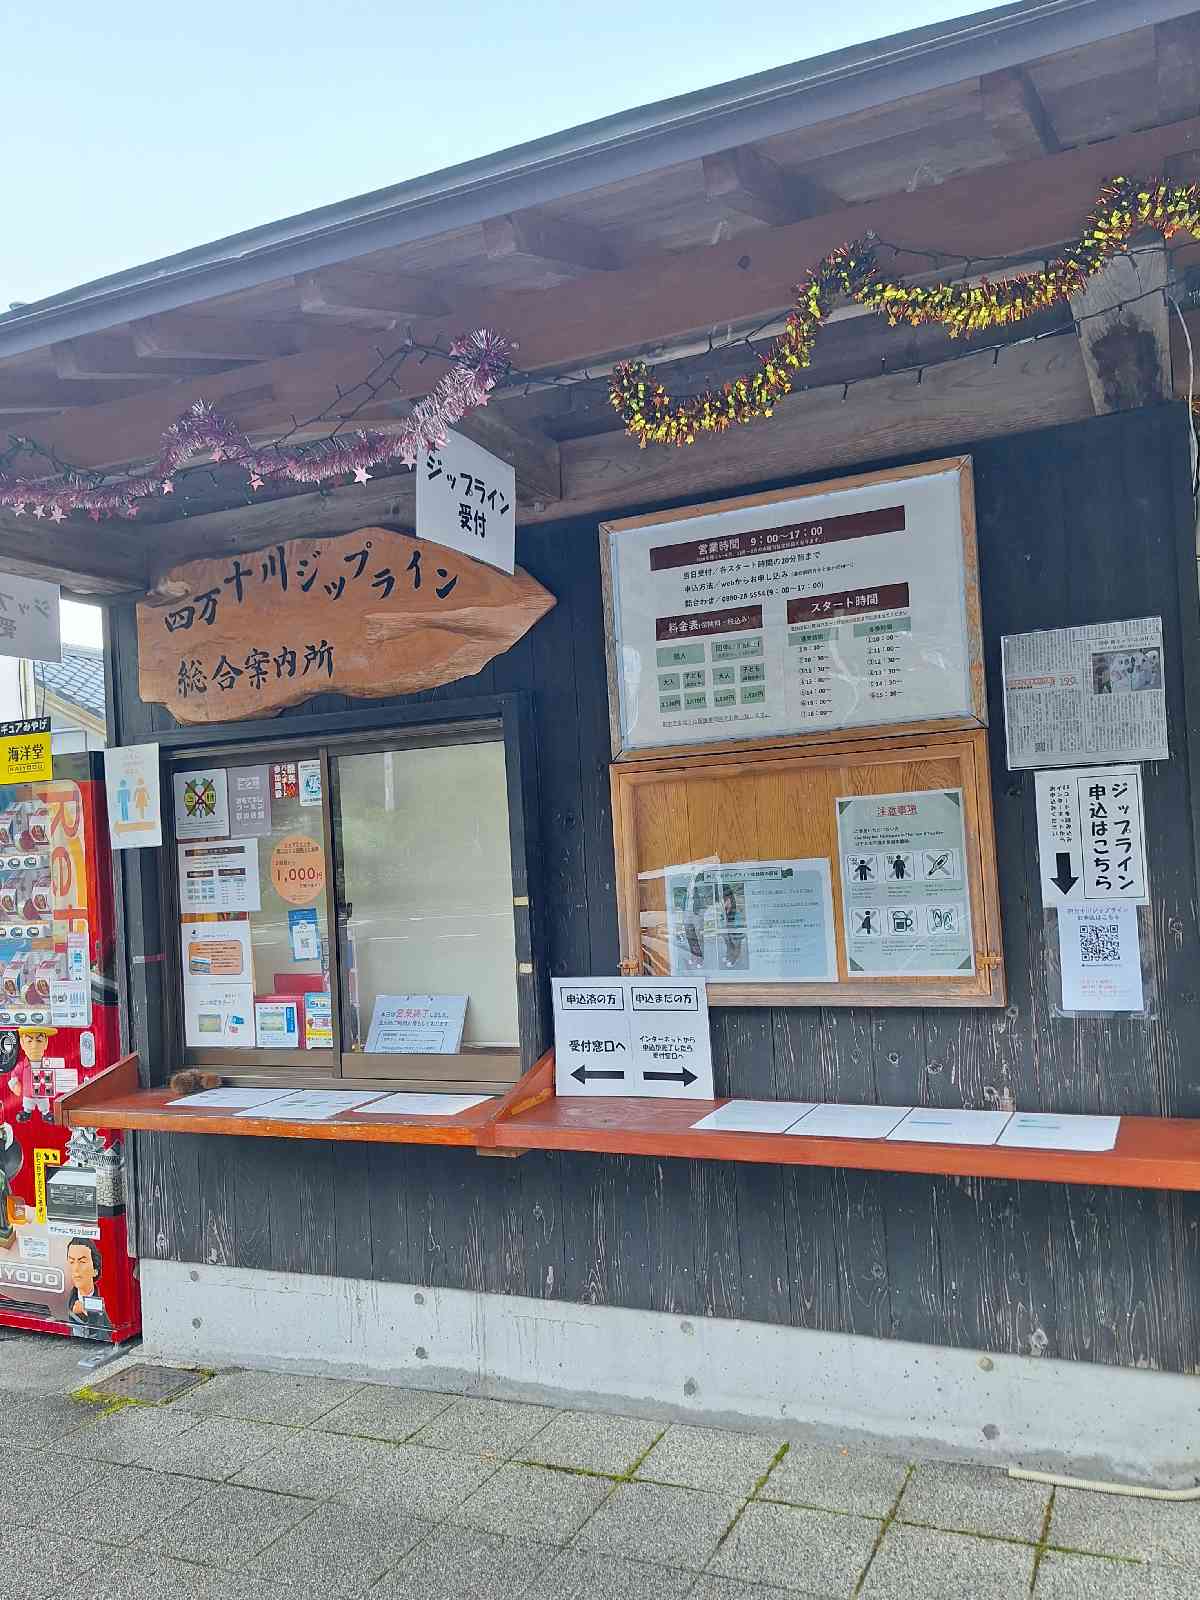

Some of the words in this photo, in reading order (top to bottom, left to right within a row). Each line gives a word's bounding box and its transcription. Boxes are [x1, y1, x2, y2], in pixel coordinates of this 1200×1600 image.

[426, 455, 510, 516] ジップライン
[458, 502, 488, 539] 受付
[697, 538, 740, 556] 営業時間
[163, 541, 458, 632] 四万十川ジップライン
[811, 593, 878, 614] スタート時間
[176, 639, 335, 698] 総合案内所
[8, 743, 44, 762] 海洋堂
[1088, 784, 1112, 890] 申込はこちら
[1111, 782, 1134, 890] ジップライン
[566, 993, 617, 1005] 申込済の方
[635, 993, 693, 1004] 申込まだの方
[569, 1039, 626, 1053] 受付窓口へ
[639, 1035, 696, 1044] インターネットから
[642, 1044, 693, 1053] 申込が完了したら
